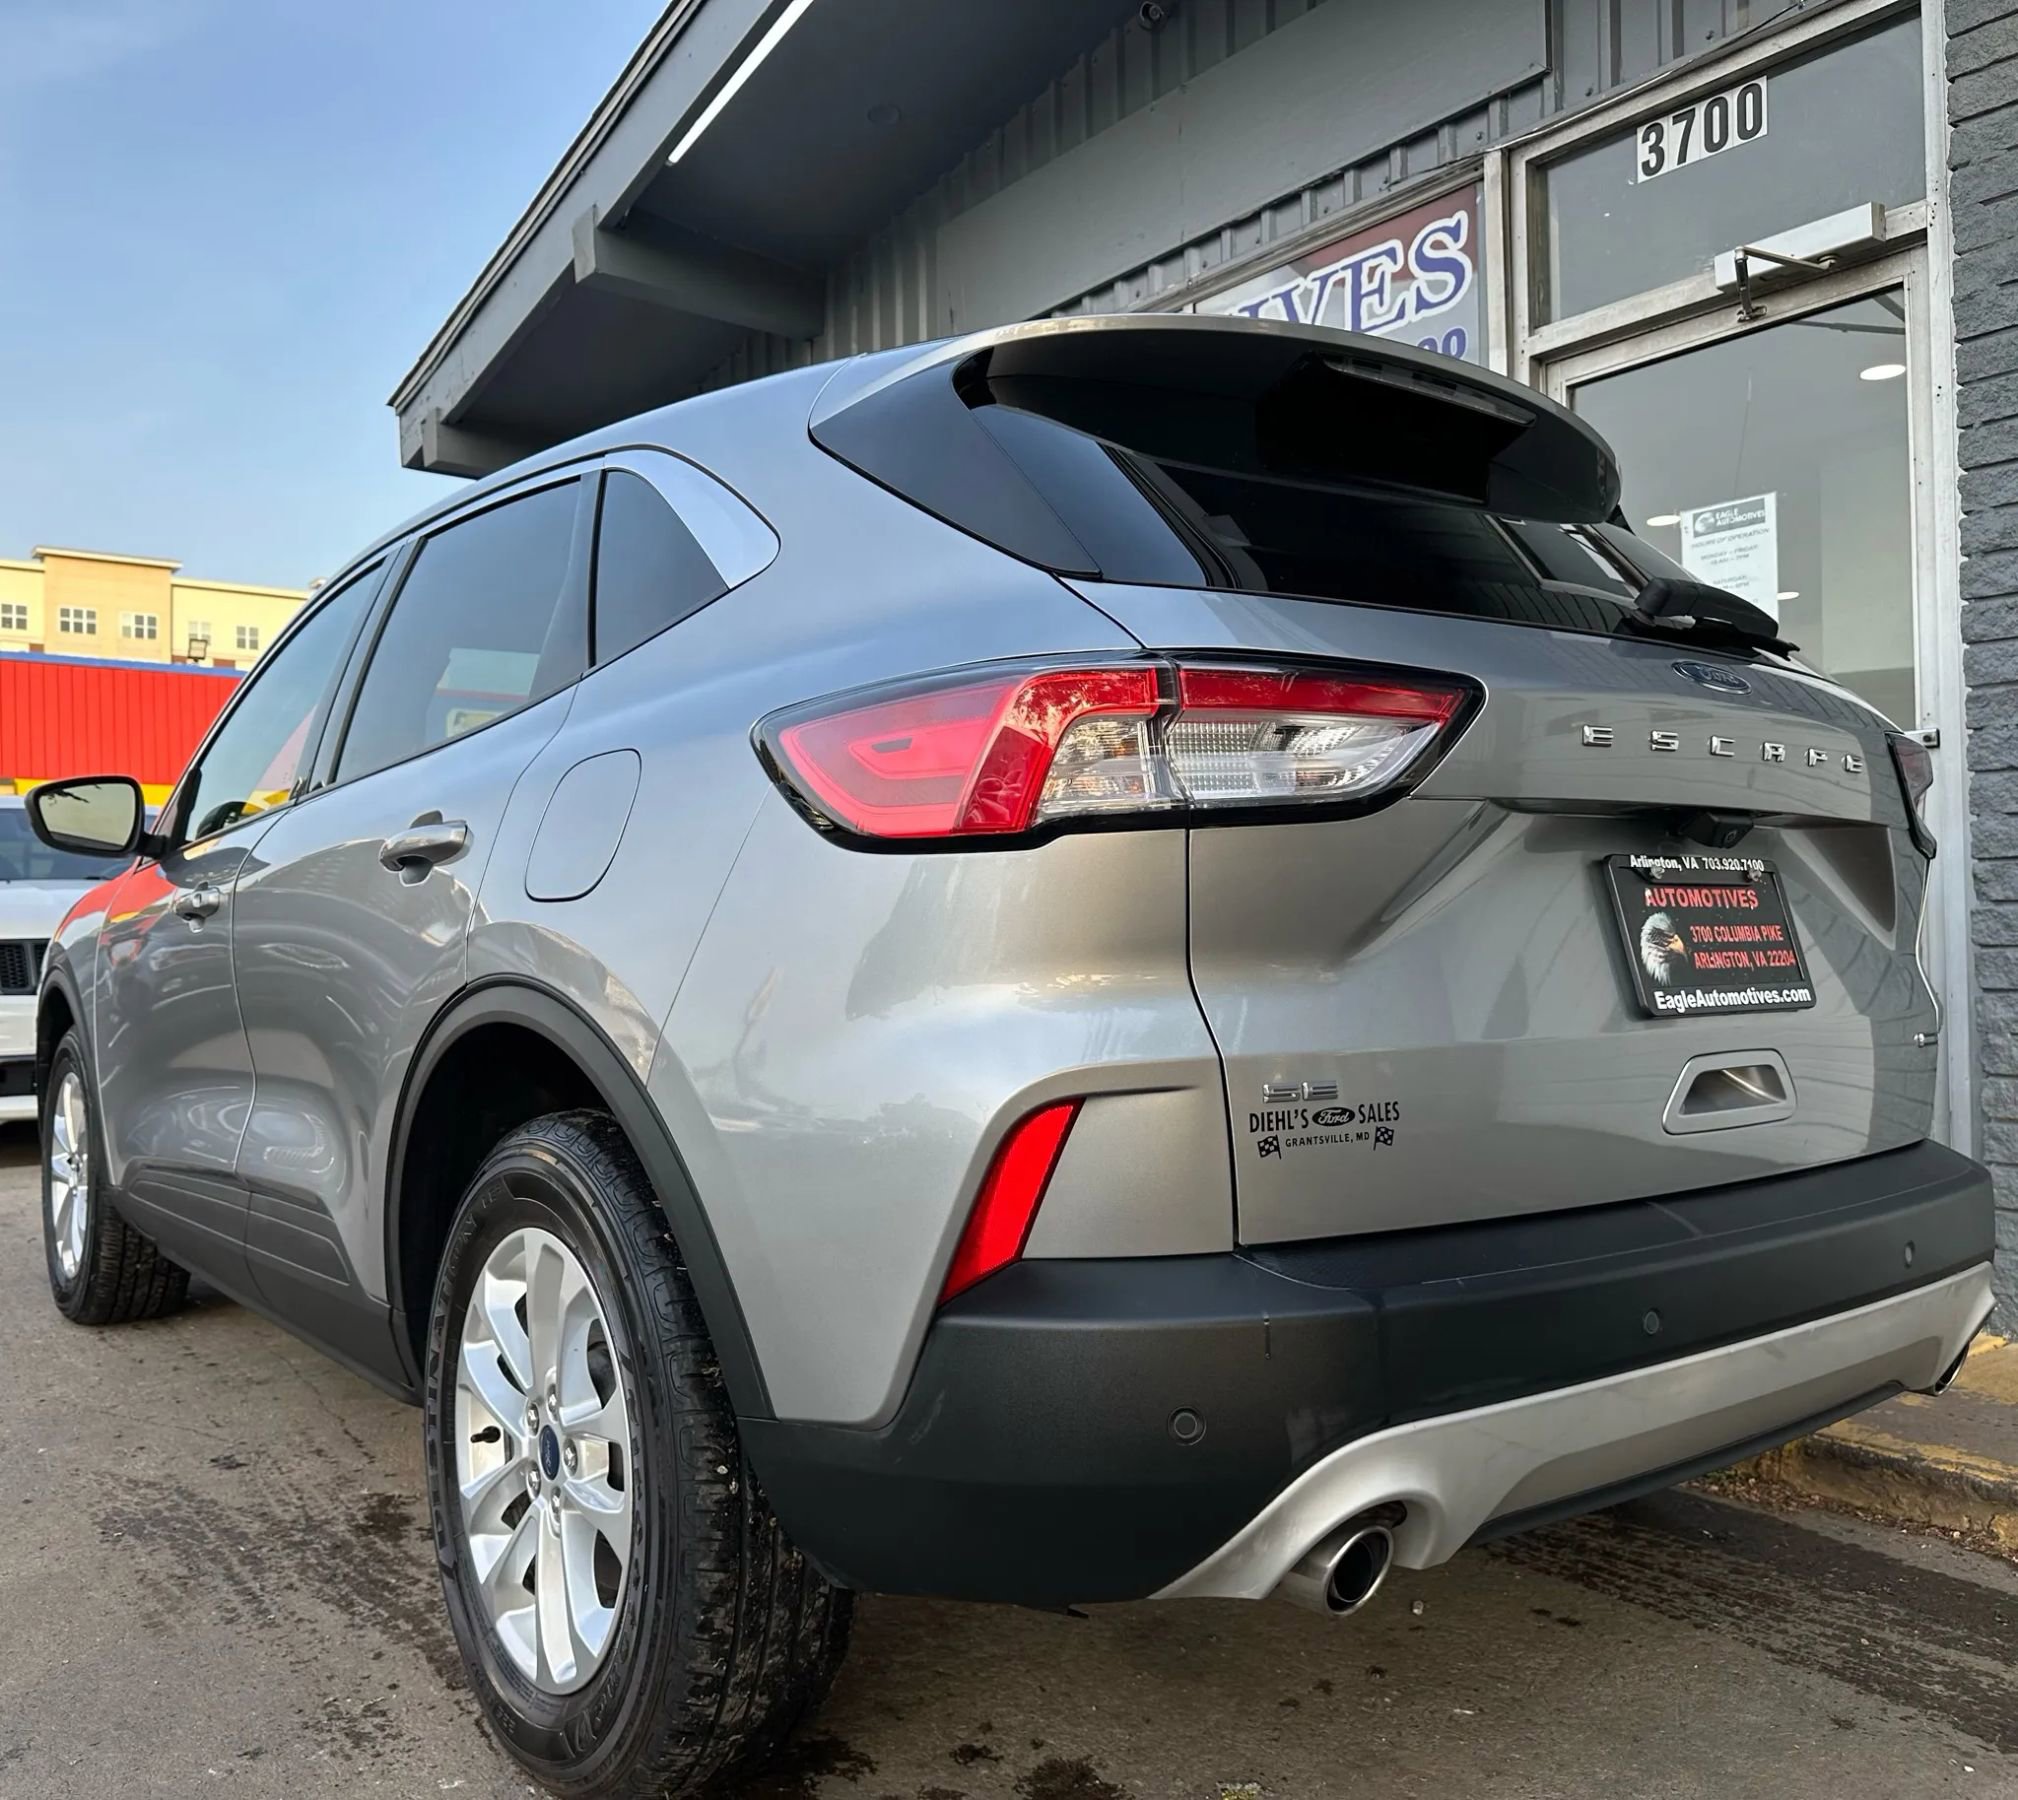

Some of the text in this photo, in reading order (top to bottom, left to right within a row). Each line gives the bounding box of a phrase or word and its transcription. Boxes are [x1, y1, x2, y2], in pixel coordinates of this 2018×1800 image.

[1641, 82, 1763, 177] 3700
[1238, 210, 1472, 334] VES
[1581, 724, 1864, 774] ESCAPE
[1682, 856, 1699, 869] VA
[1702, 857, 1765, 872] 703.920.7100
[1645, 887, 1759, 909] AUTOMOTIVES
[1690, 925, 1784, 943] 3700 COLUMBIA PIKE
[1754, 952, 1767, 967] VA
[1768, 951, 1796, 967] 22204
[1654, 987, 1812, 1013] EagleAutomotives.com
[1262, 1080, 1339, 1103] SE
[1249, 1101, 1400, 1133] DIEHL'S Ford SALES
[1285, 1131, 1370, 1148] GRANTSVILLE, MD
